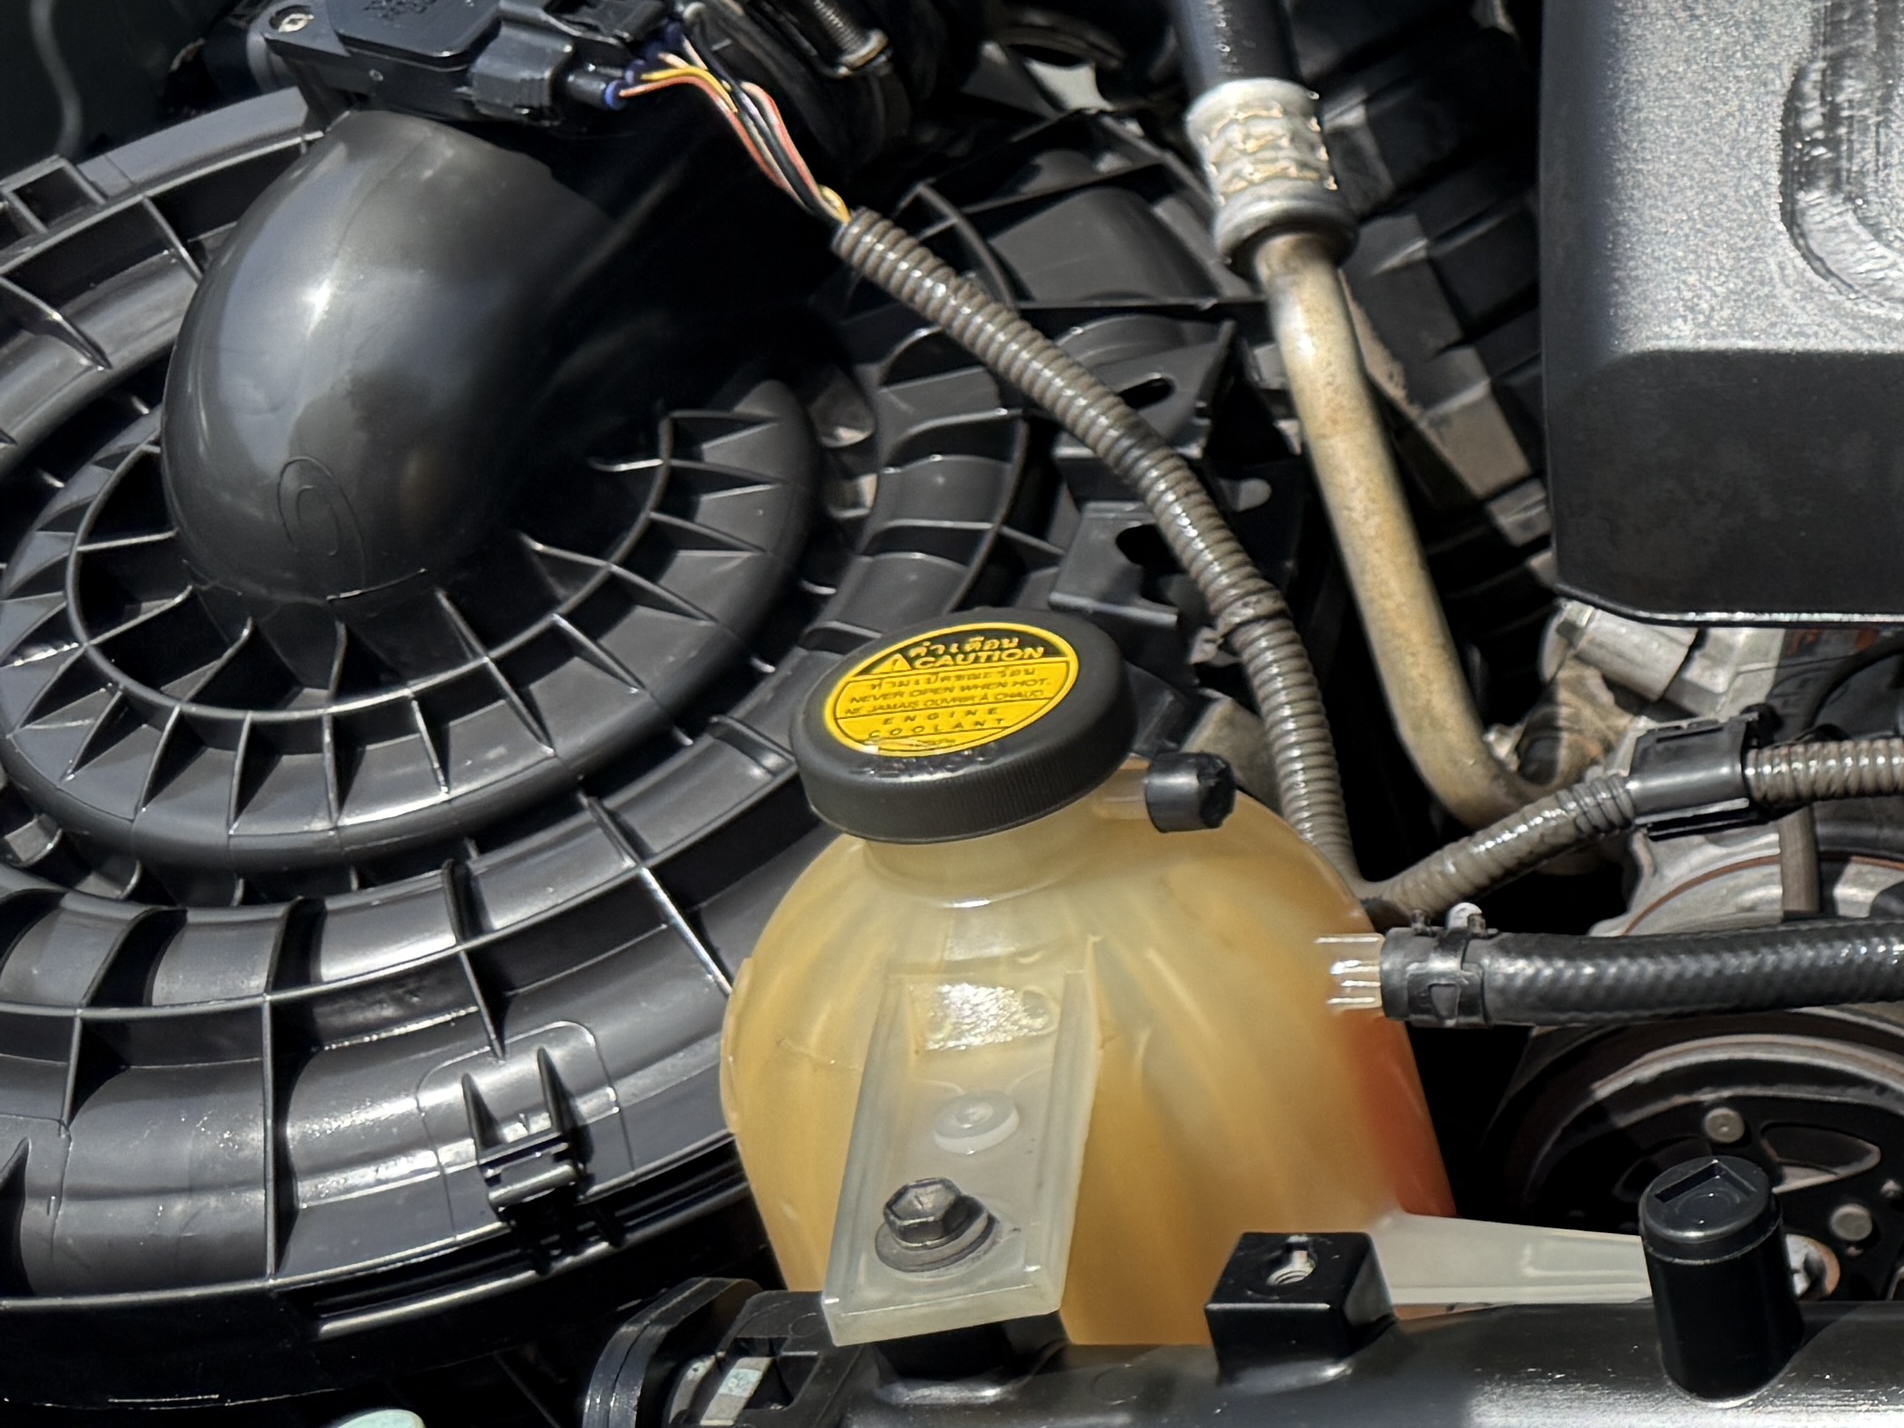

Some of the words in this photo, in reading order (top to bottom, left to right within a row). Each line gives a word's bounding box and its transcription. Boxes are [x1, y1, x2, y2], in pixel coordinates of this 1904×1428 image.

[914, 647, 1046, 669] CAUTION
[849, 691, 905, 705] NEVER
[909, 685, 955, 698] OPEN
[960, 680, 1007, 693] WHEN
[883, 706, 1000, 727] ENGINE
[867, 717, 1005, 739] COOLANT
